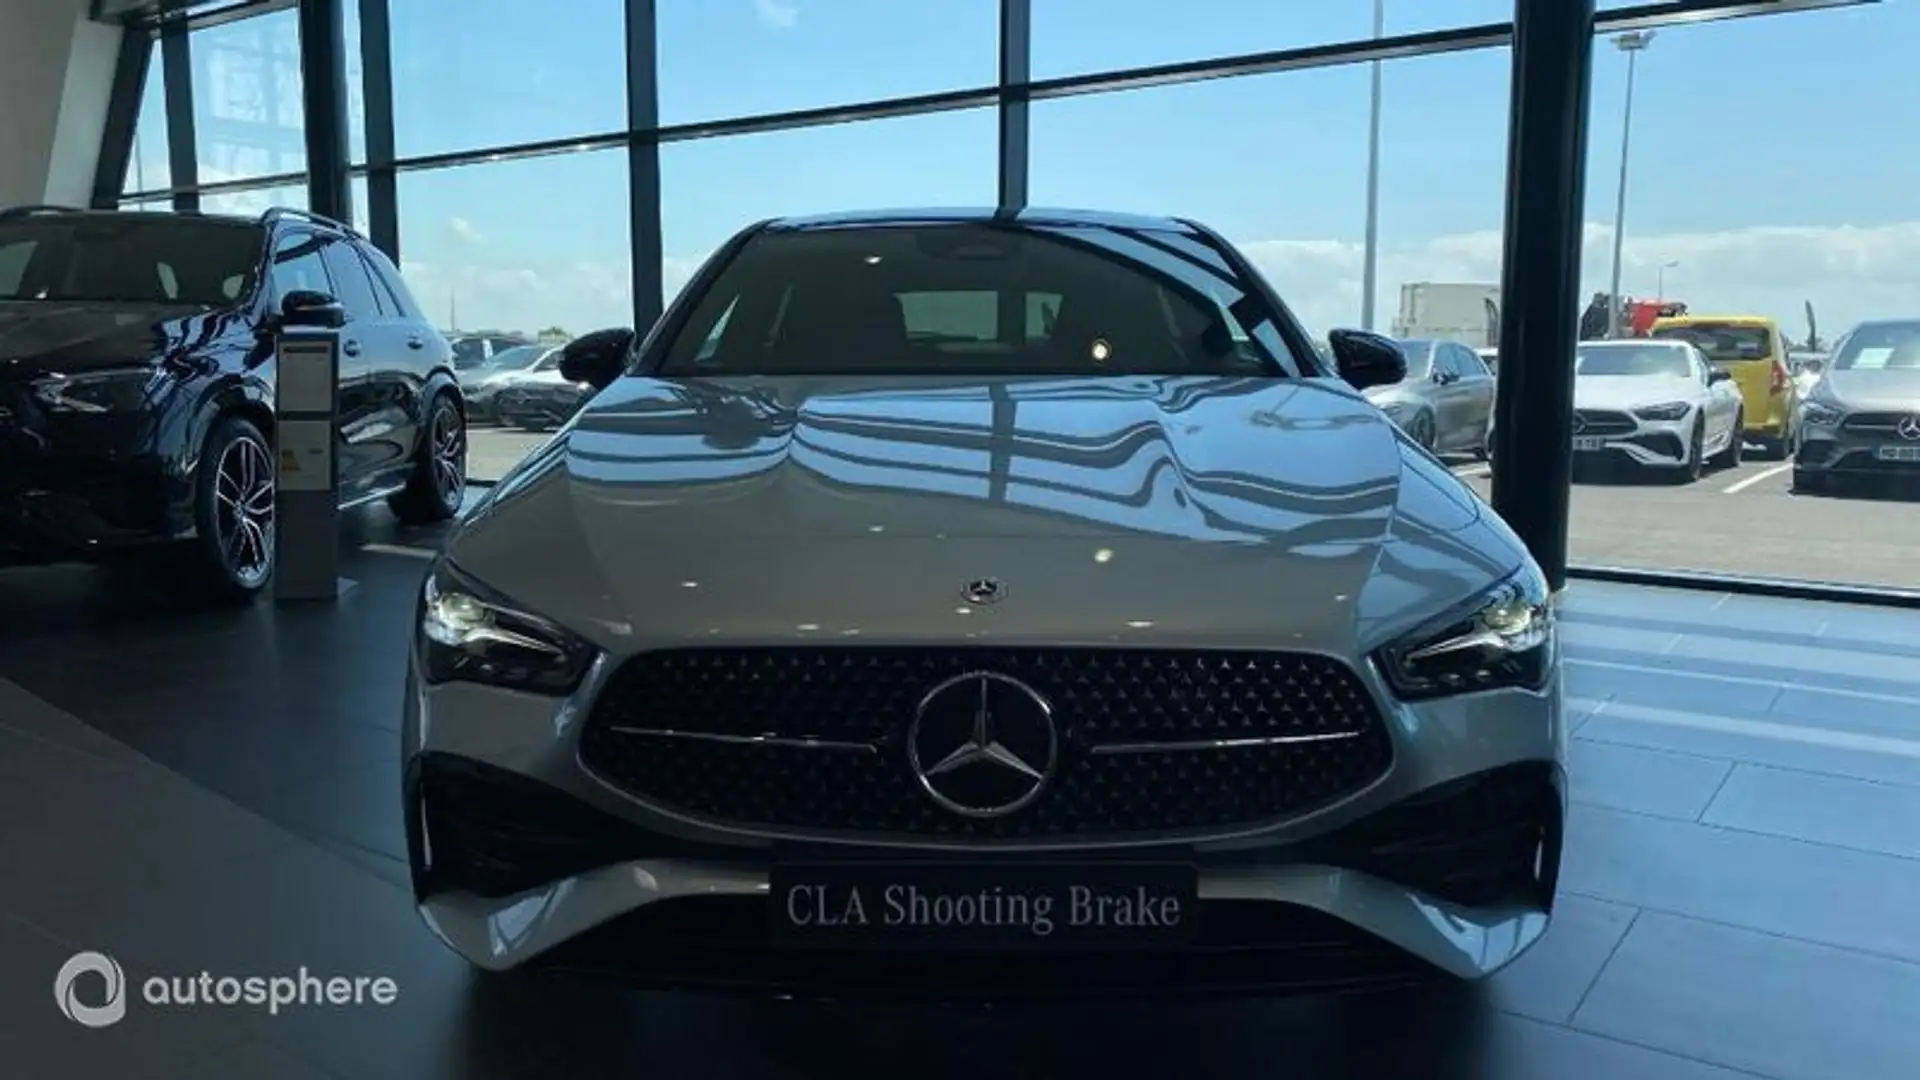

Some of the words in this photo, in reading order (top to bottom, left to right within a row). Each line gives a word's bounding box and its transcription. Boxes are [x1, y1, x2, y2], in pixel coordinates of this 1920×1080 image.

[786, 884, 868, 926] CLA
[884, 883, 1054, 936] Shooting
[1068, 884, 1181, 926] Brake
